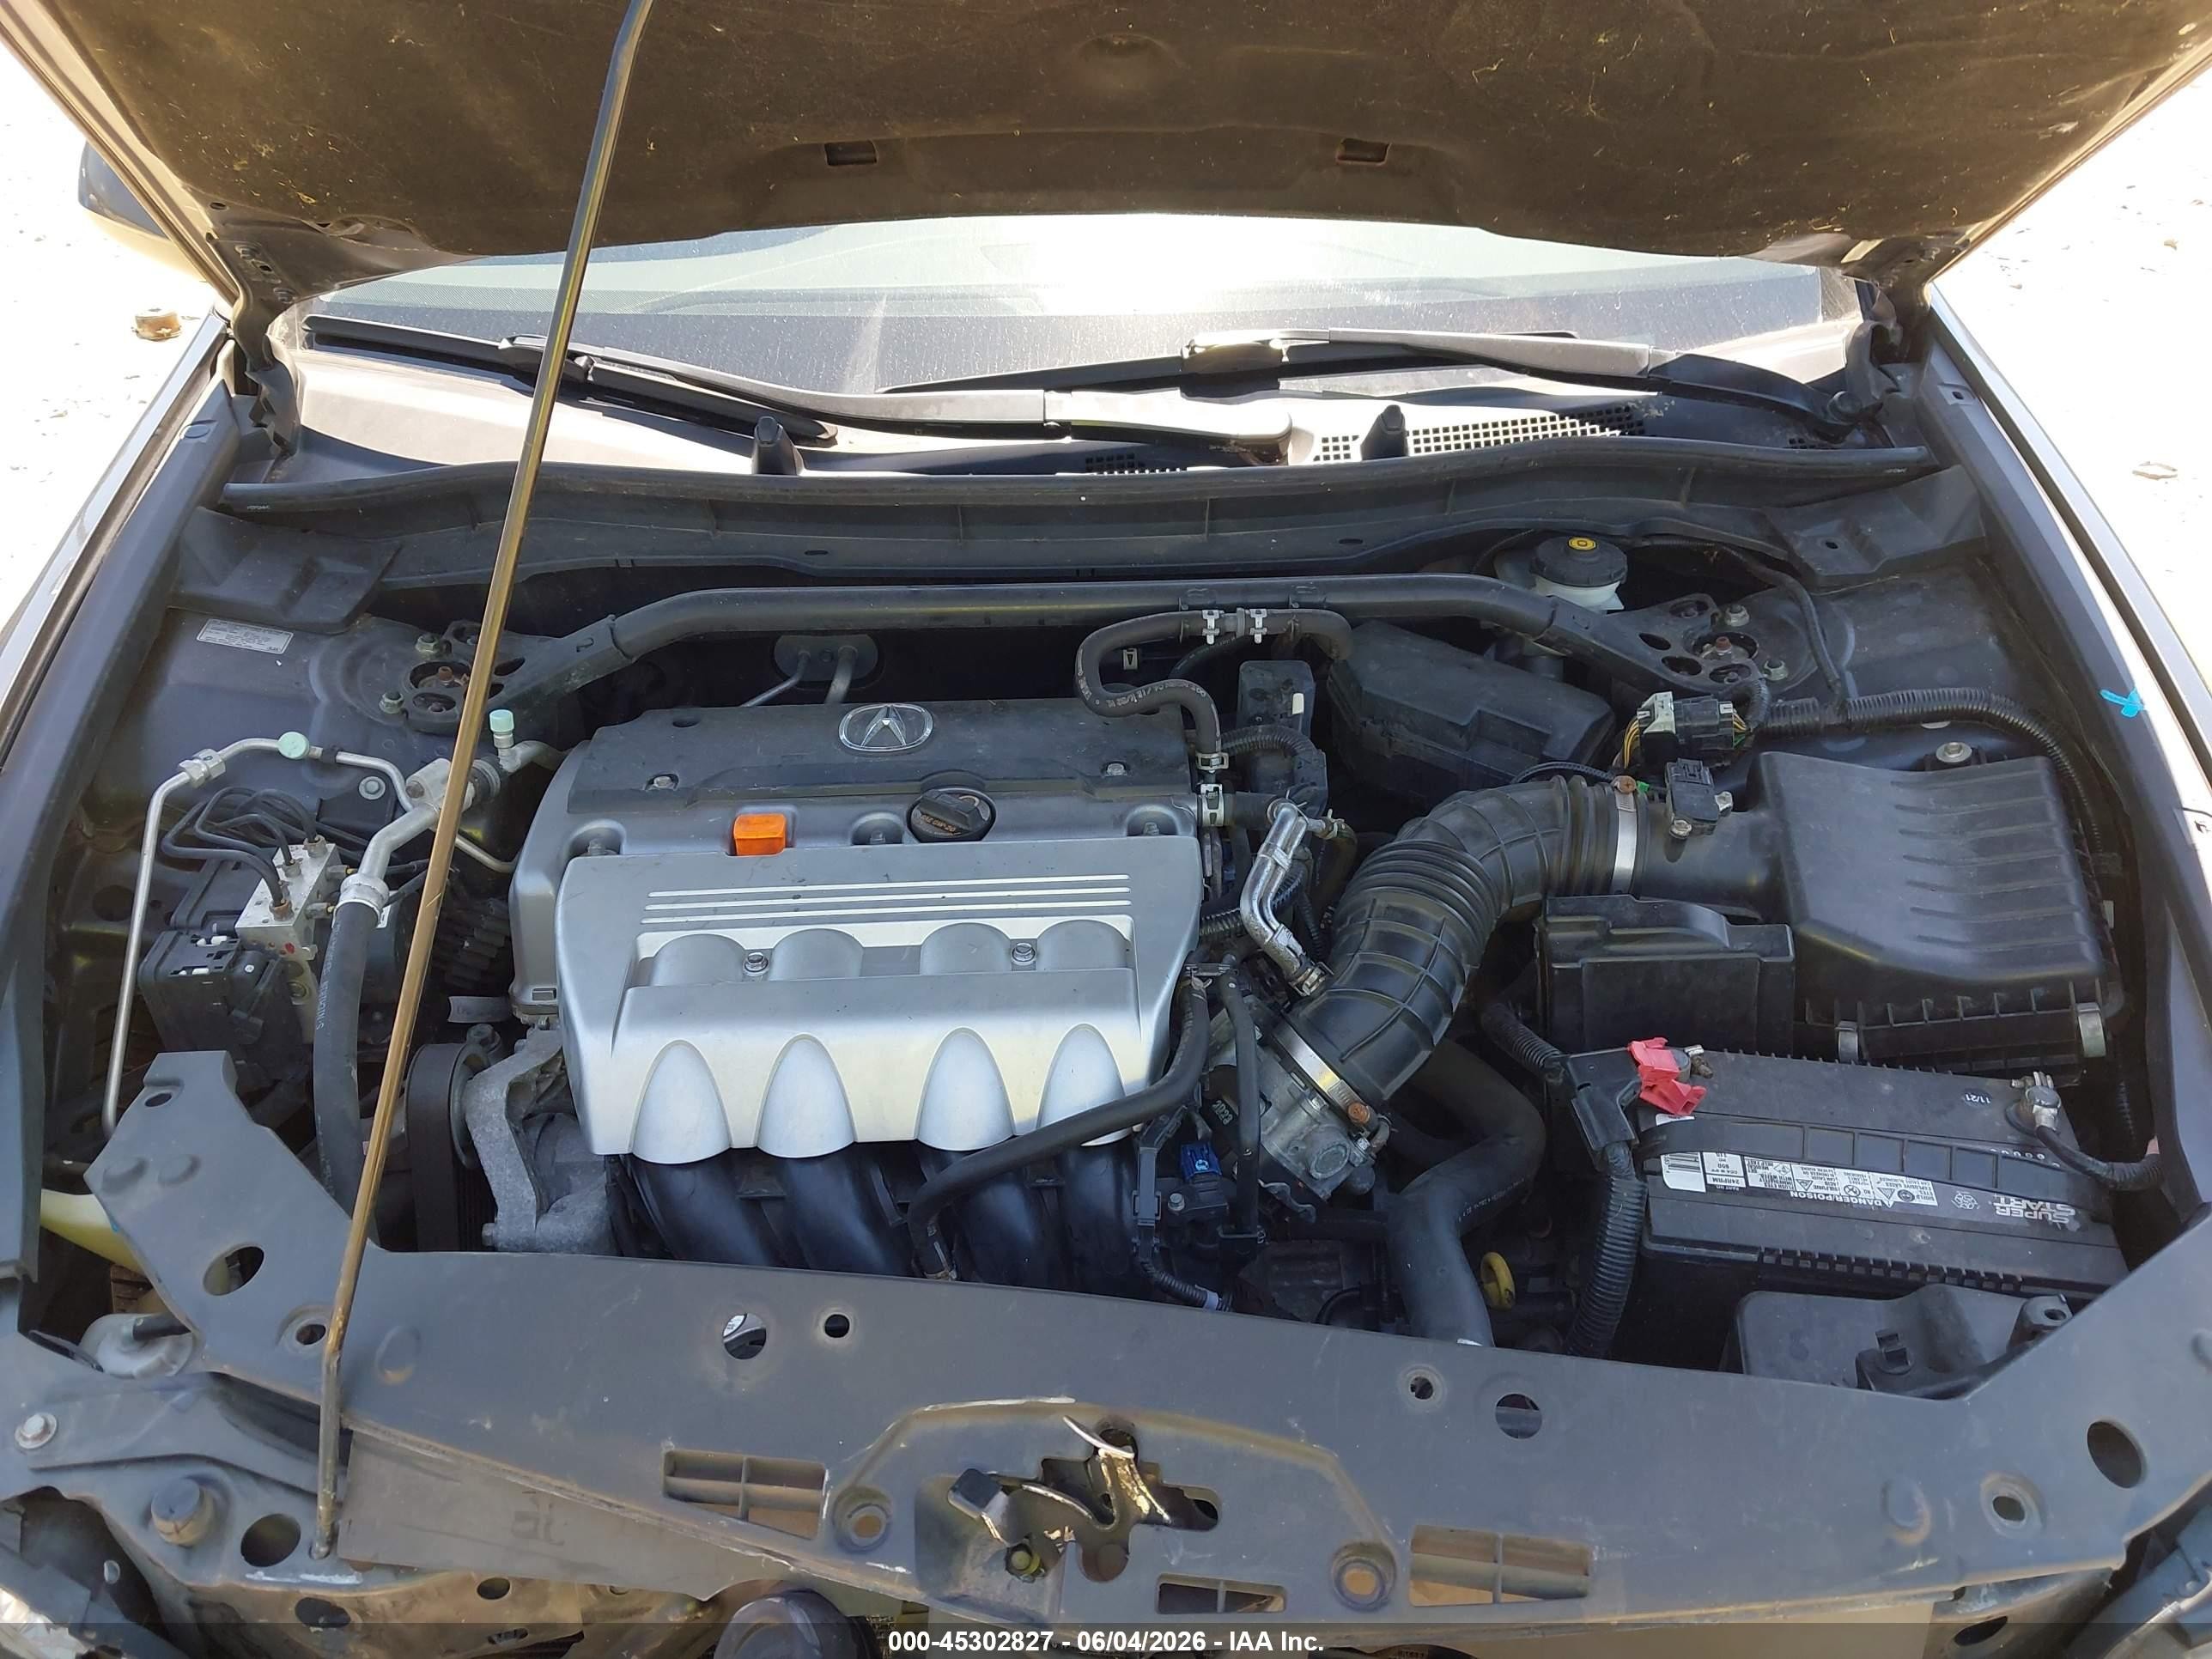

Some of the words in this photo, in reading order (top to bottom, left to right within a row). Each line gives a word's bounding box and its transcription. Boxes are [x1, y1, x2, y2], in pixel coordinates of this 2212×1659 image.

[1965, 1094, 1991, 1104] 11/21
[1790, 1191, 1882, 1206] DANGER/POISON
[1993, 1196, 2075, 1215] START
[1996, 1206, 2069, 1224] SUPER
